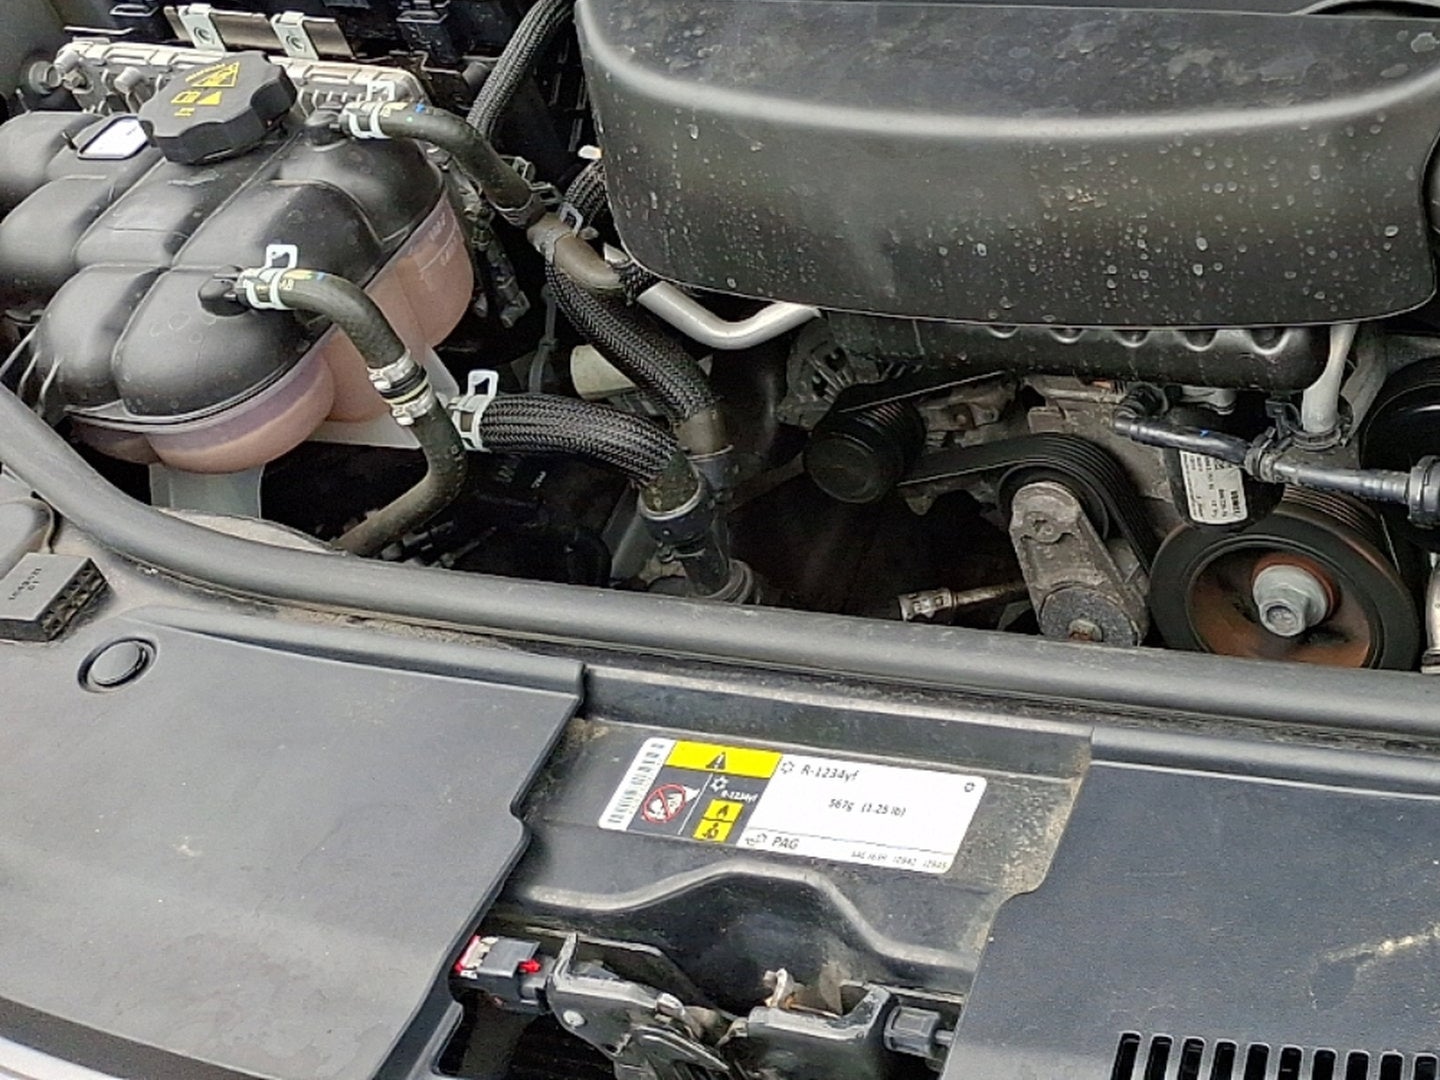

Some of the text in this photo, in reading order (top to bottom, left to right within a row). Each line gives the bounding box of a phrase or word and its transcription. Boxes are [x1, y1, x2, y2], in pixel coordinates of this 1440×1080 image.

[801, 764, 859, 782] R-1234yf
[829, 798, 854, 812] 567g
[771, 836, 799, 850] PAG
